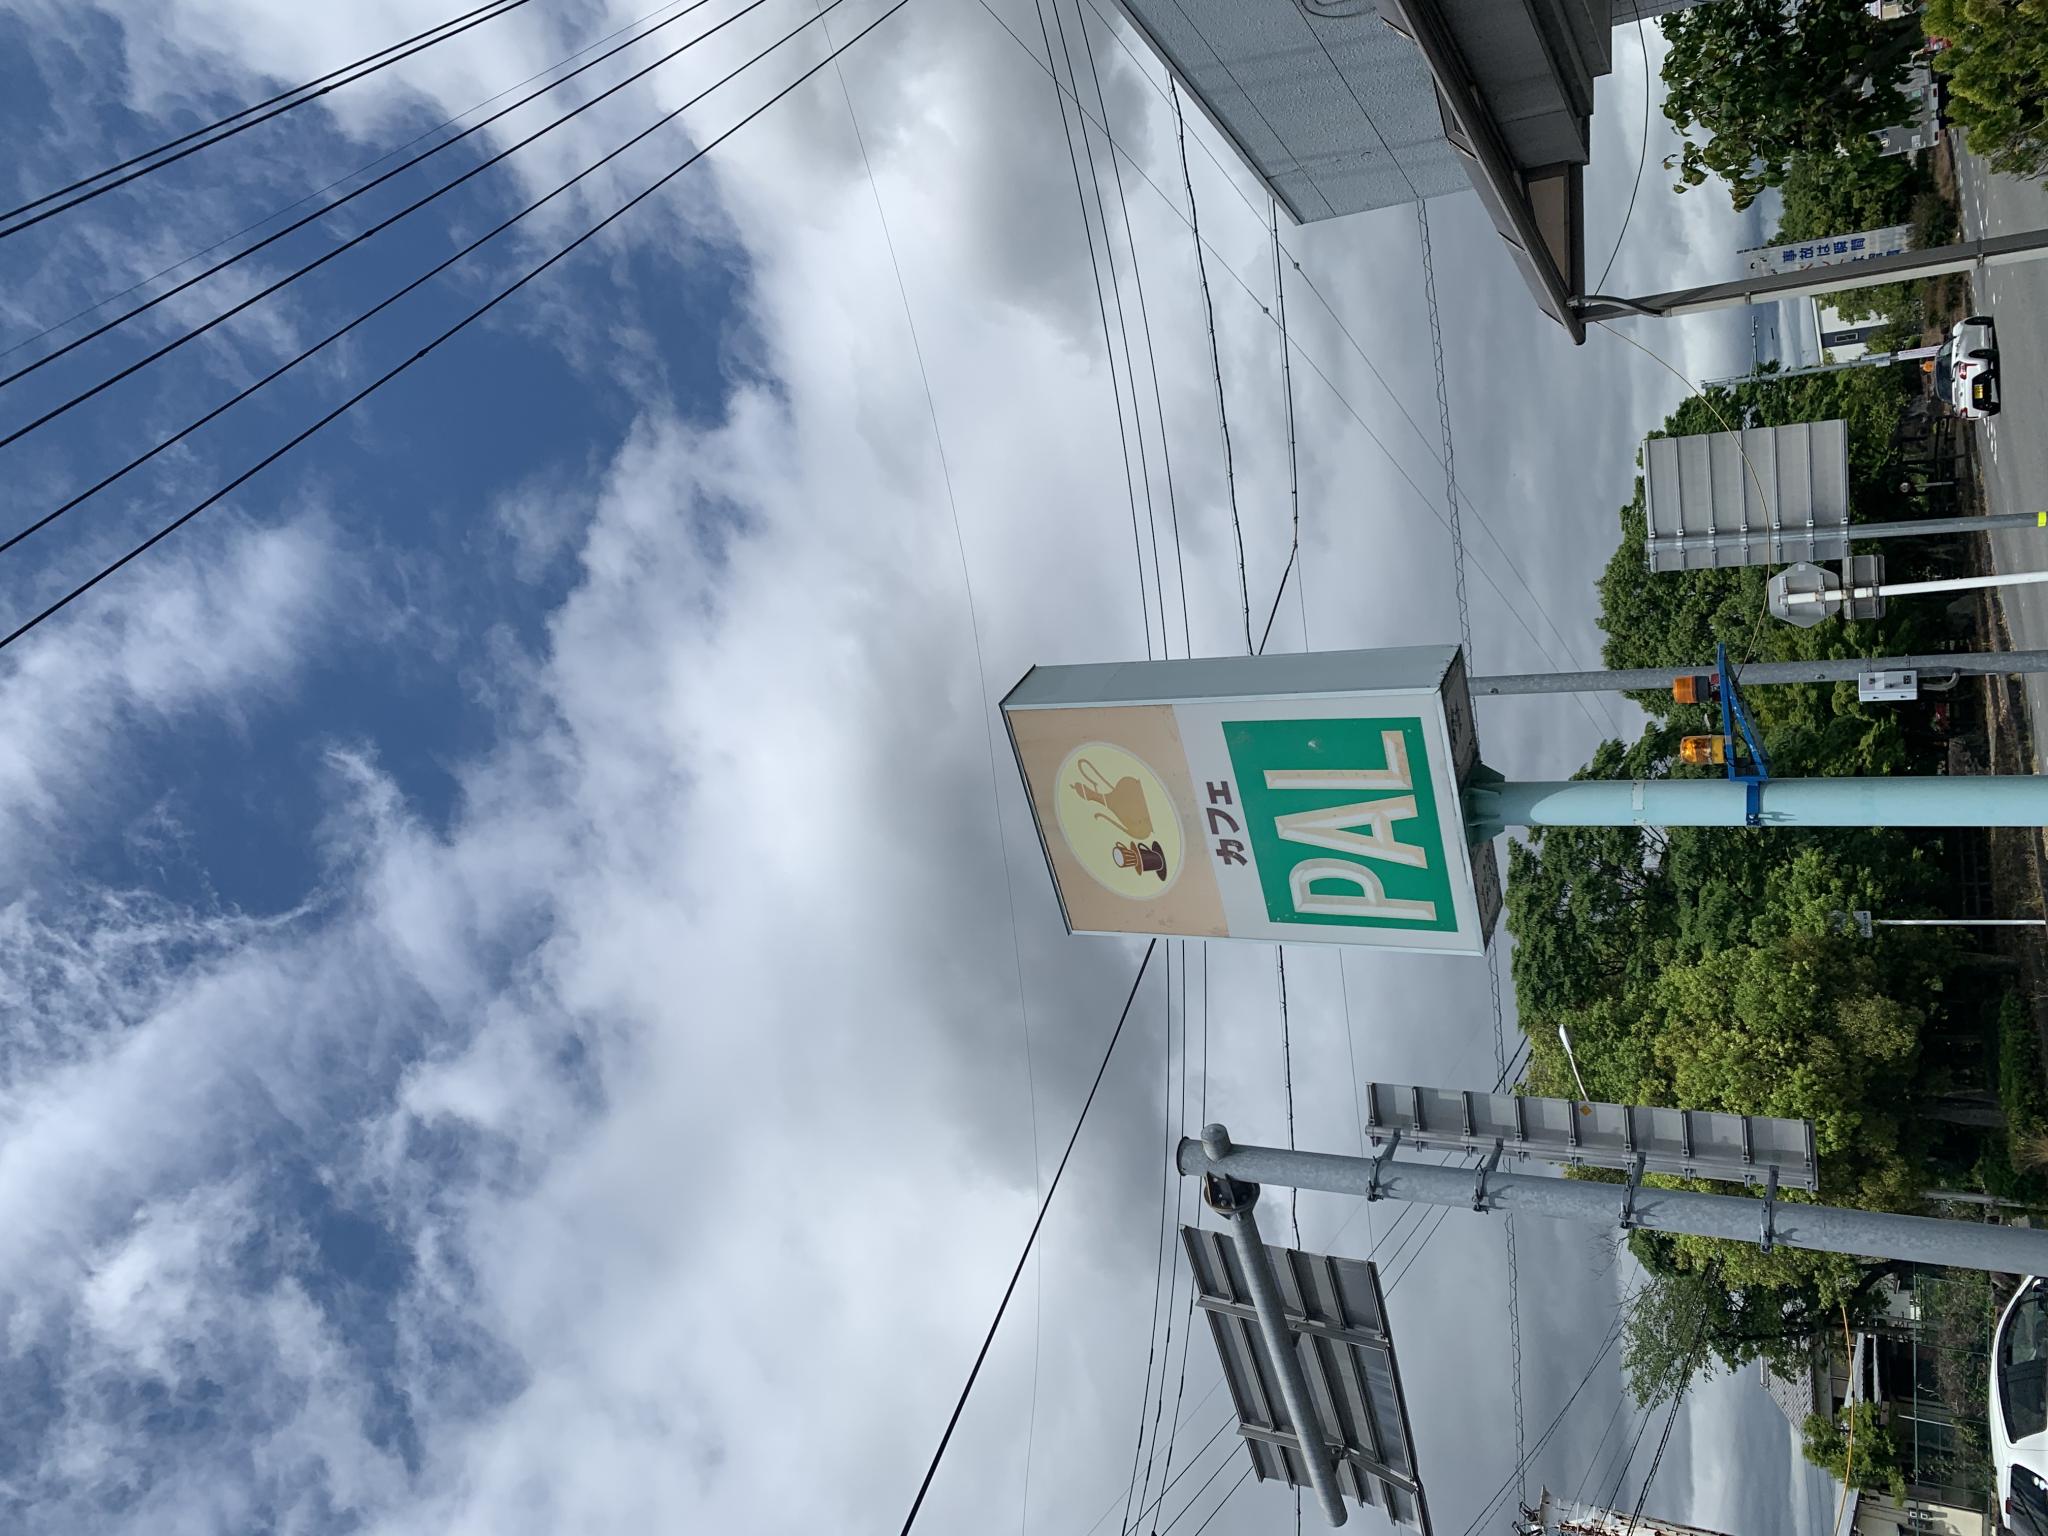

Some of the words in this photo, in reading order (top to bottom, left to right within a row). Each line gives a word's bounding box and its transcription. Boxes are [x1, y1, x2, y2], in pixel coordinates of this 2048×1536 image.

[1782, 237, 1866, 263] 事故は瞬間
[1206, 781, 1248, 866] カフェ
[1263, 730, 1437, 921] PAL
